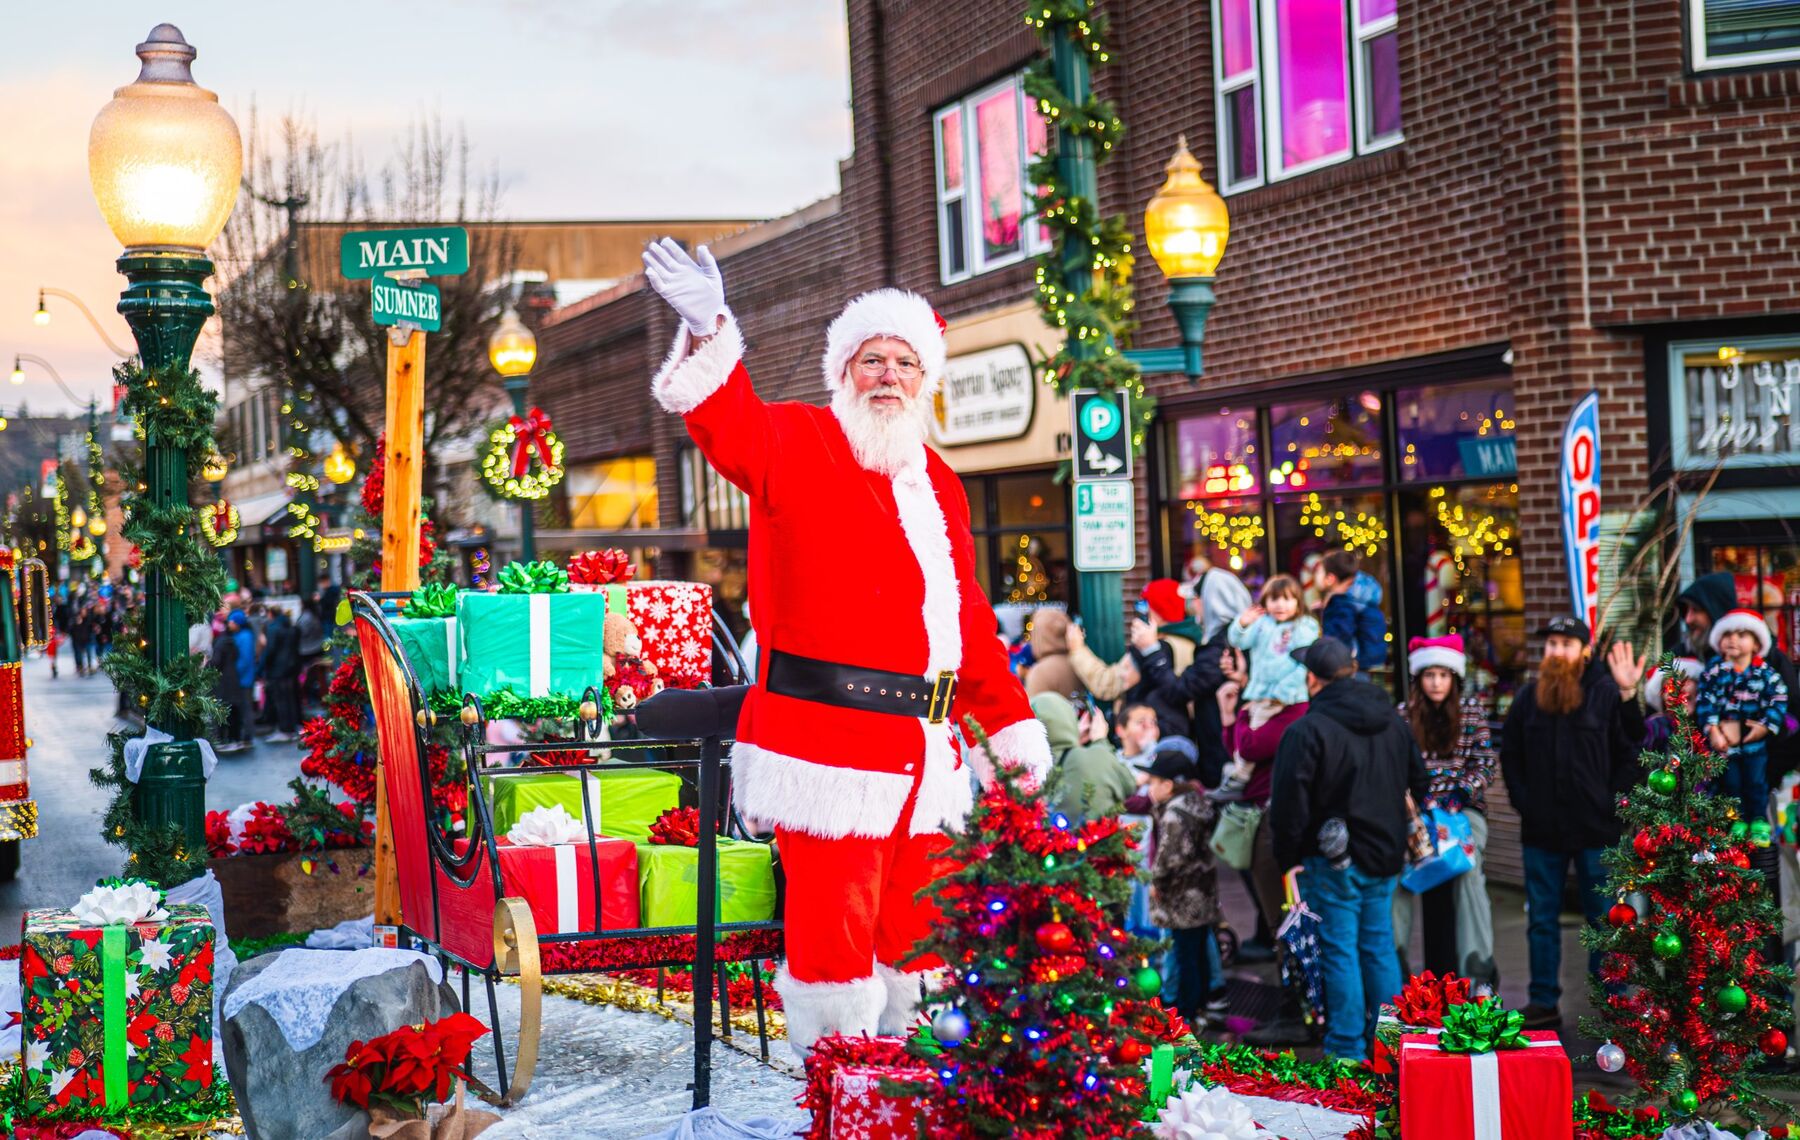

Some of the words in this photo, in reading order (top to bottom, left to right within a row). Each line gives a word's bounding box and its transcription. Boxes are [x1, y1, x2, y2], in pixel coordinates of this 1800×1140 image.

[359, 238, 450, 268] MAIN
[374, 285, 439, 321] SUMNER
[1770, 386, 1792, 416] N
[1090, 407, 1112, 433] P
[1080, 489, 1091, 512] 3
